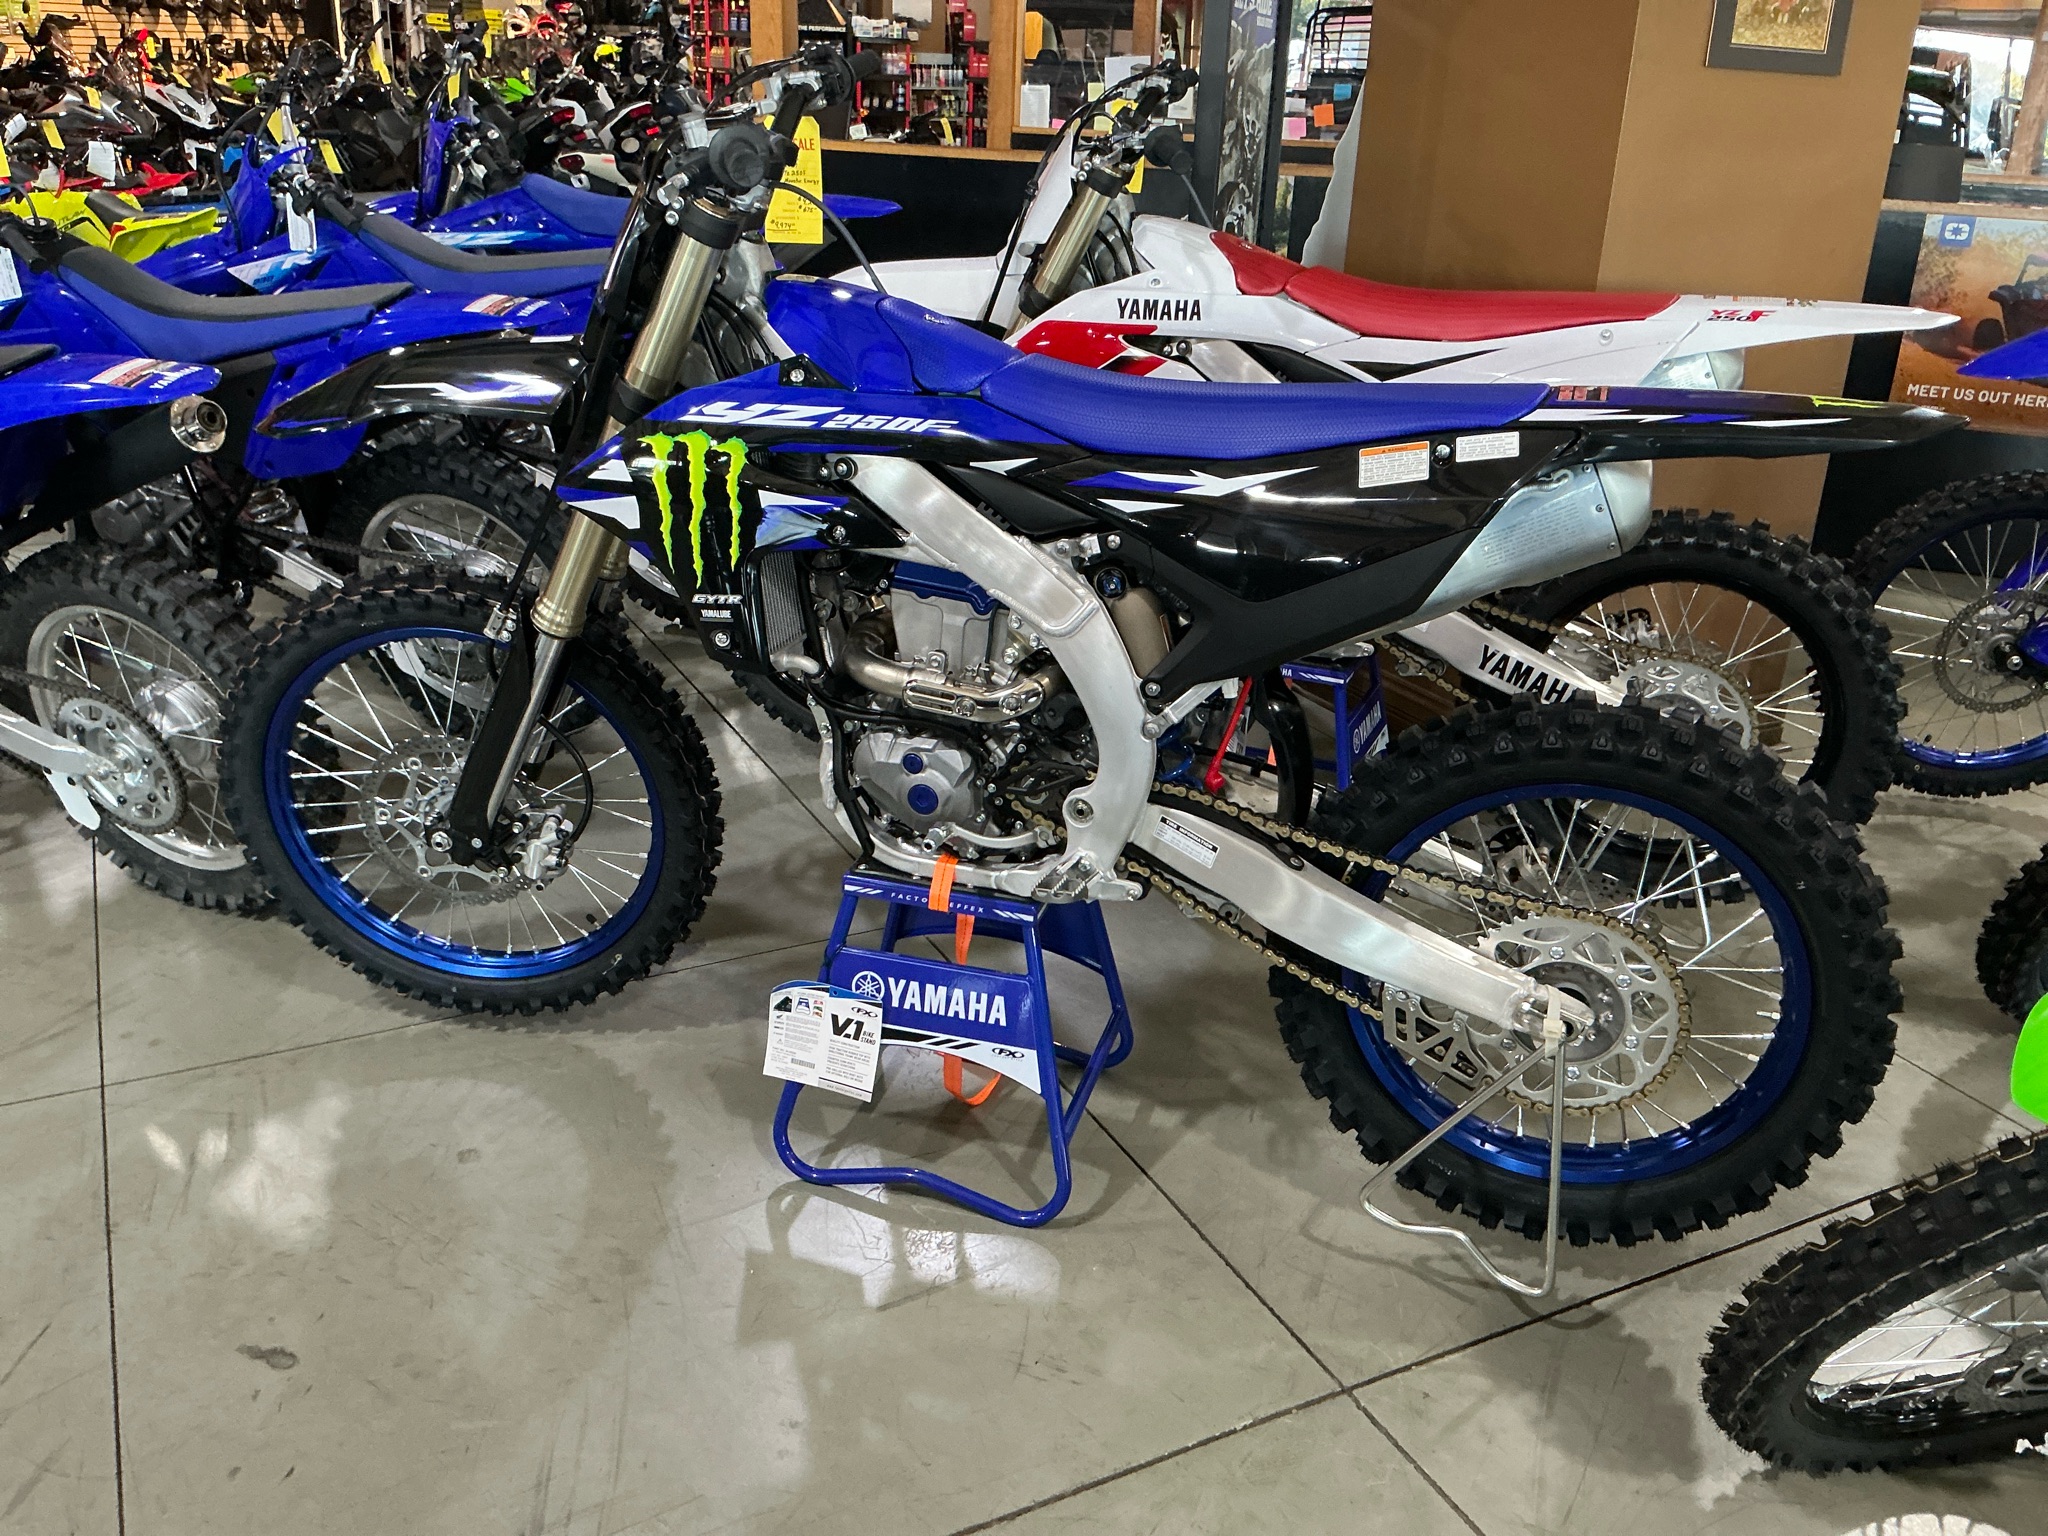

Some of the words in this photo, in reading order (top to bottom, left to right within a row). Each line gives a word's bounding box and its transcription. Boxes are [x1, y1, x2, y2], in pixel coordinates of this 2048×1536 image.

[1117, 298, 1202, 321] YAMAHA
[1907, 383, 1950, 399] MEET
[1953, 387, 1975, 401] US
[1978, 390, 2011, 405] OUT
[2014, 393, 2048, 408] HER
[677, 401, 845, 427] YZ
[820, 413, 960, 433] 250F
[691, 593, 743, 605] GYTR
[700, 609, 732, 618] YAMALUBE
[1358, 700, 1382, 745] YAMAHA
[1165, 819, 1178, 829] TIRE
[1179, 827, 1214, 850] INFORMATION
[949, 902, 985, 913] EFFEX
[887, 976, 1007, 1027] YAMAHA
[831, 1013, 865, 1042] V.1
[863, 1030, 876, 1040] BIKE
[860, 1037, 877, 1046] STAND
